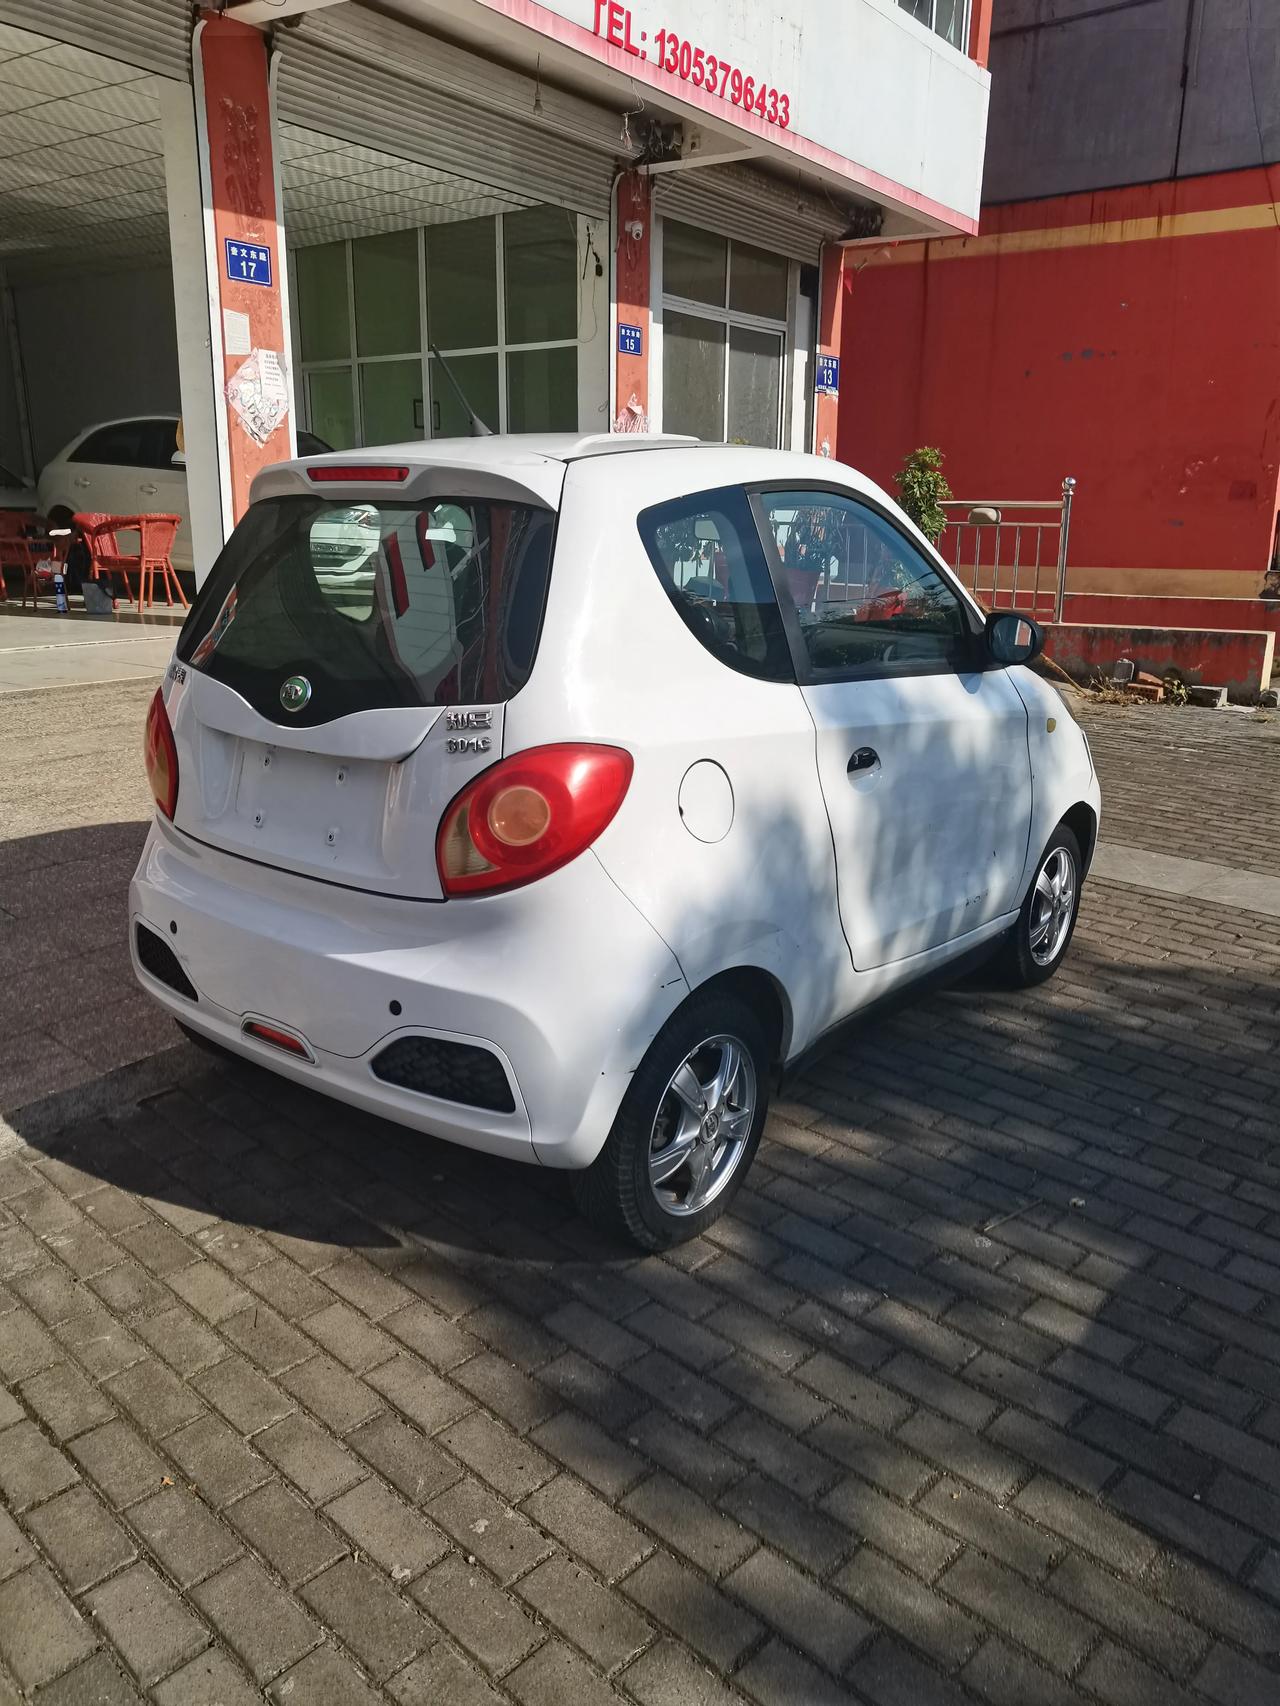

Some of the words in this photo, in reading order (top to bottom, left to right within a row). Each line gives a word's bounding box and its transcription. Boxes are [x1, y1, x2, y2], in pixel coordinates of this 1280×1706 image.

[592, 0, 647, 60] TEL:
[654, 28, 790, 129] 13053796433
[240, 261, 257, 278] 17
[625, 338, 635, 350] 15
[823, 368, 833, 385] 13
